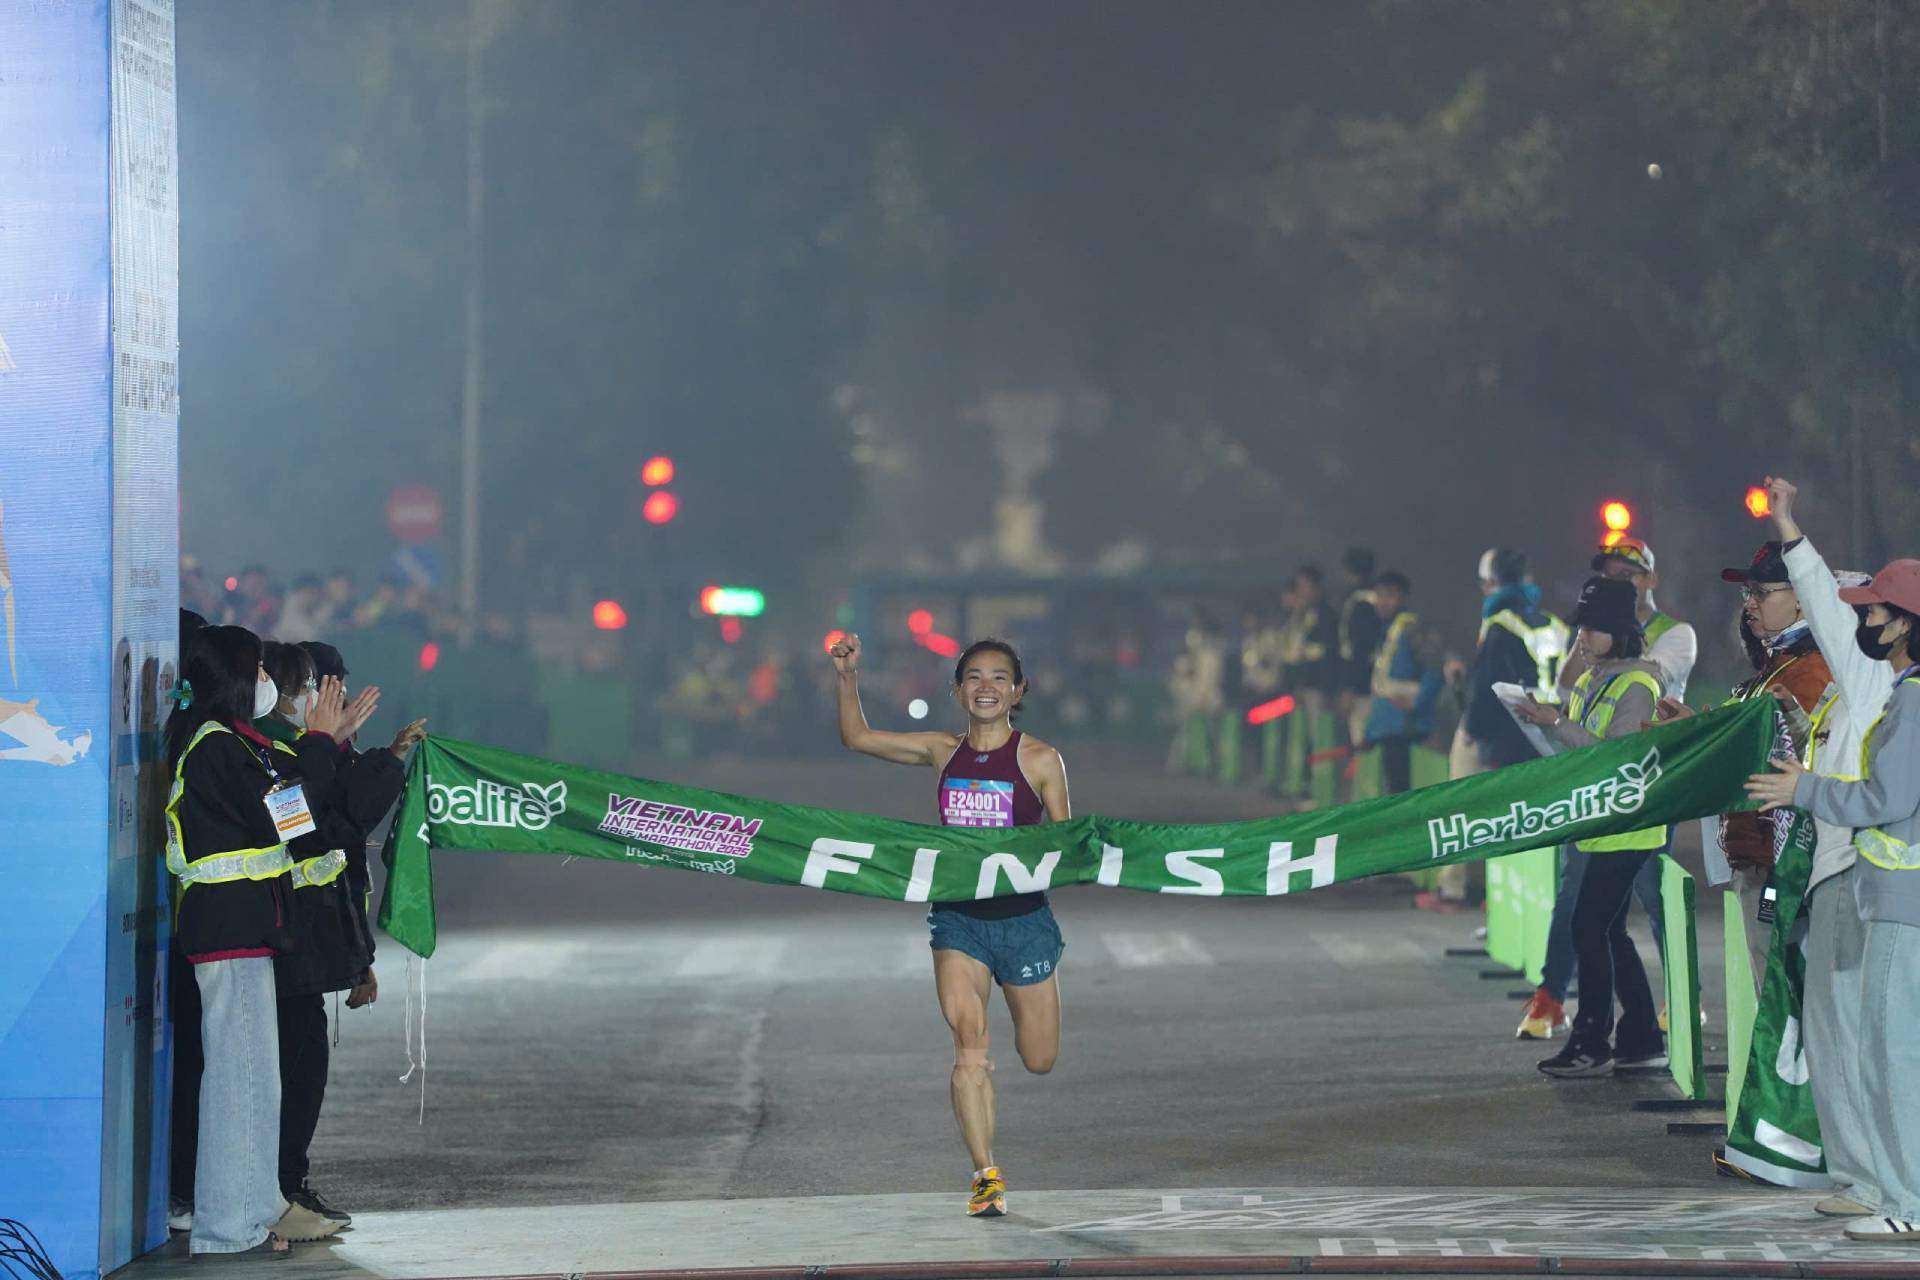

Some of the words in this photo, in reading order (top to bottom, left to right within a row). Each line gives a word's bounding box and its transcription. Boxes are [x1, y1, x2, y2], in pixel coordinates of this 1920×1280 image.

[608, 793, 763, 836] VIETNAM
[949, 790, 1000, 812] E24001
[1428, 774, 1646, 858] Herbalife
[598, 824, 636, 838] HALF
[636, 832, 717, 853] MARATHON
[716, 843, 754, 858] 2025
[603, 814, 754, 848] INTERNATIONAL
[800, 833, 1339, 903] FINISH
